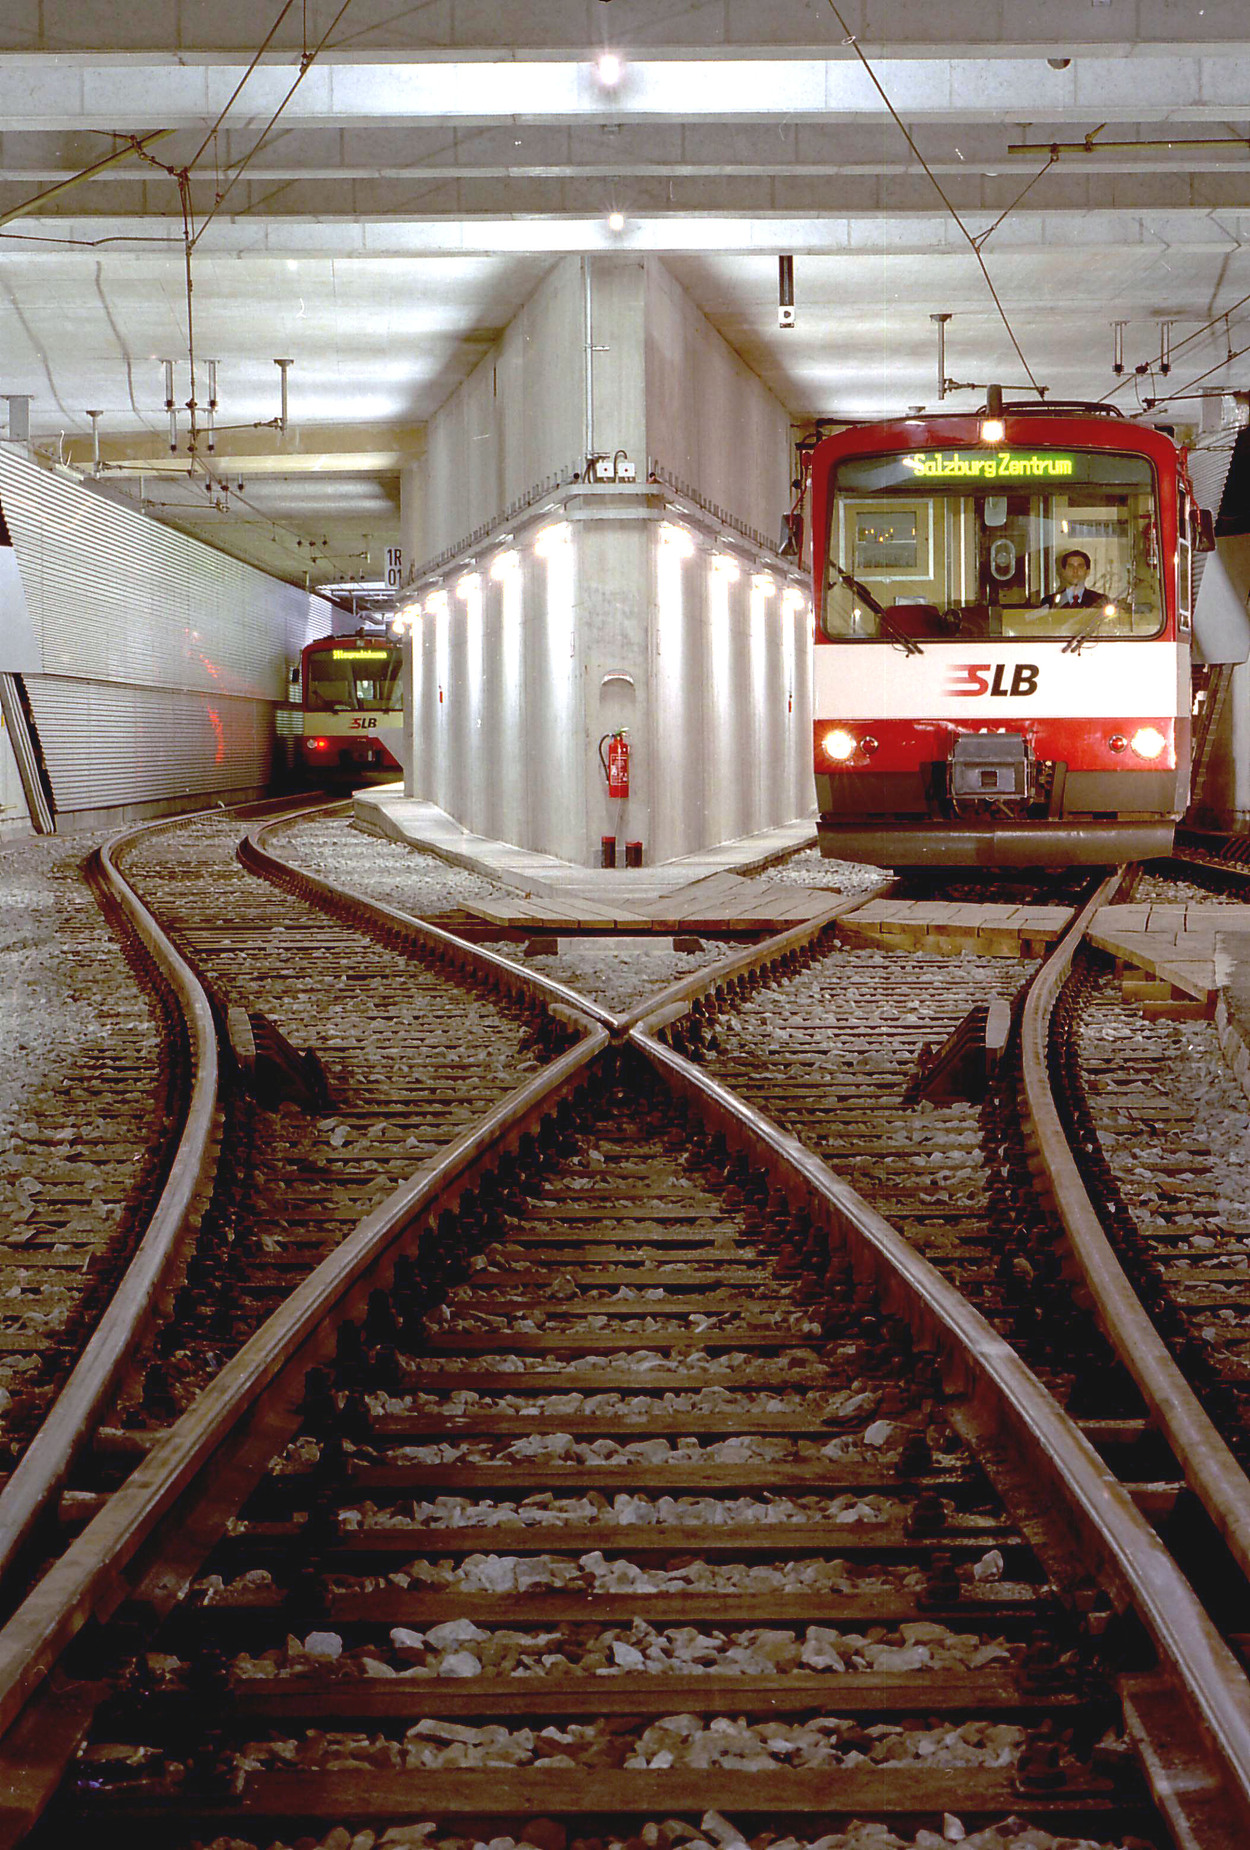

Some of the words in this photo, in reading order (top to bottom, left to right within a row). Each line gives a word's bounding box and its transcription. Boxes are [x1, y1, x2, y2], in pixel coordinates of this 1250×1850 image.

[912, 453, 996, 477] Salzburg
[997, 453, 1073, 475] Zentrum
[387, 548, 402, 566] 1R
[388, 568, 402, 586] 01
[944, 663, 1040, 697] SLB
[348, 717, 377, 729] SLB
